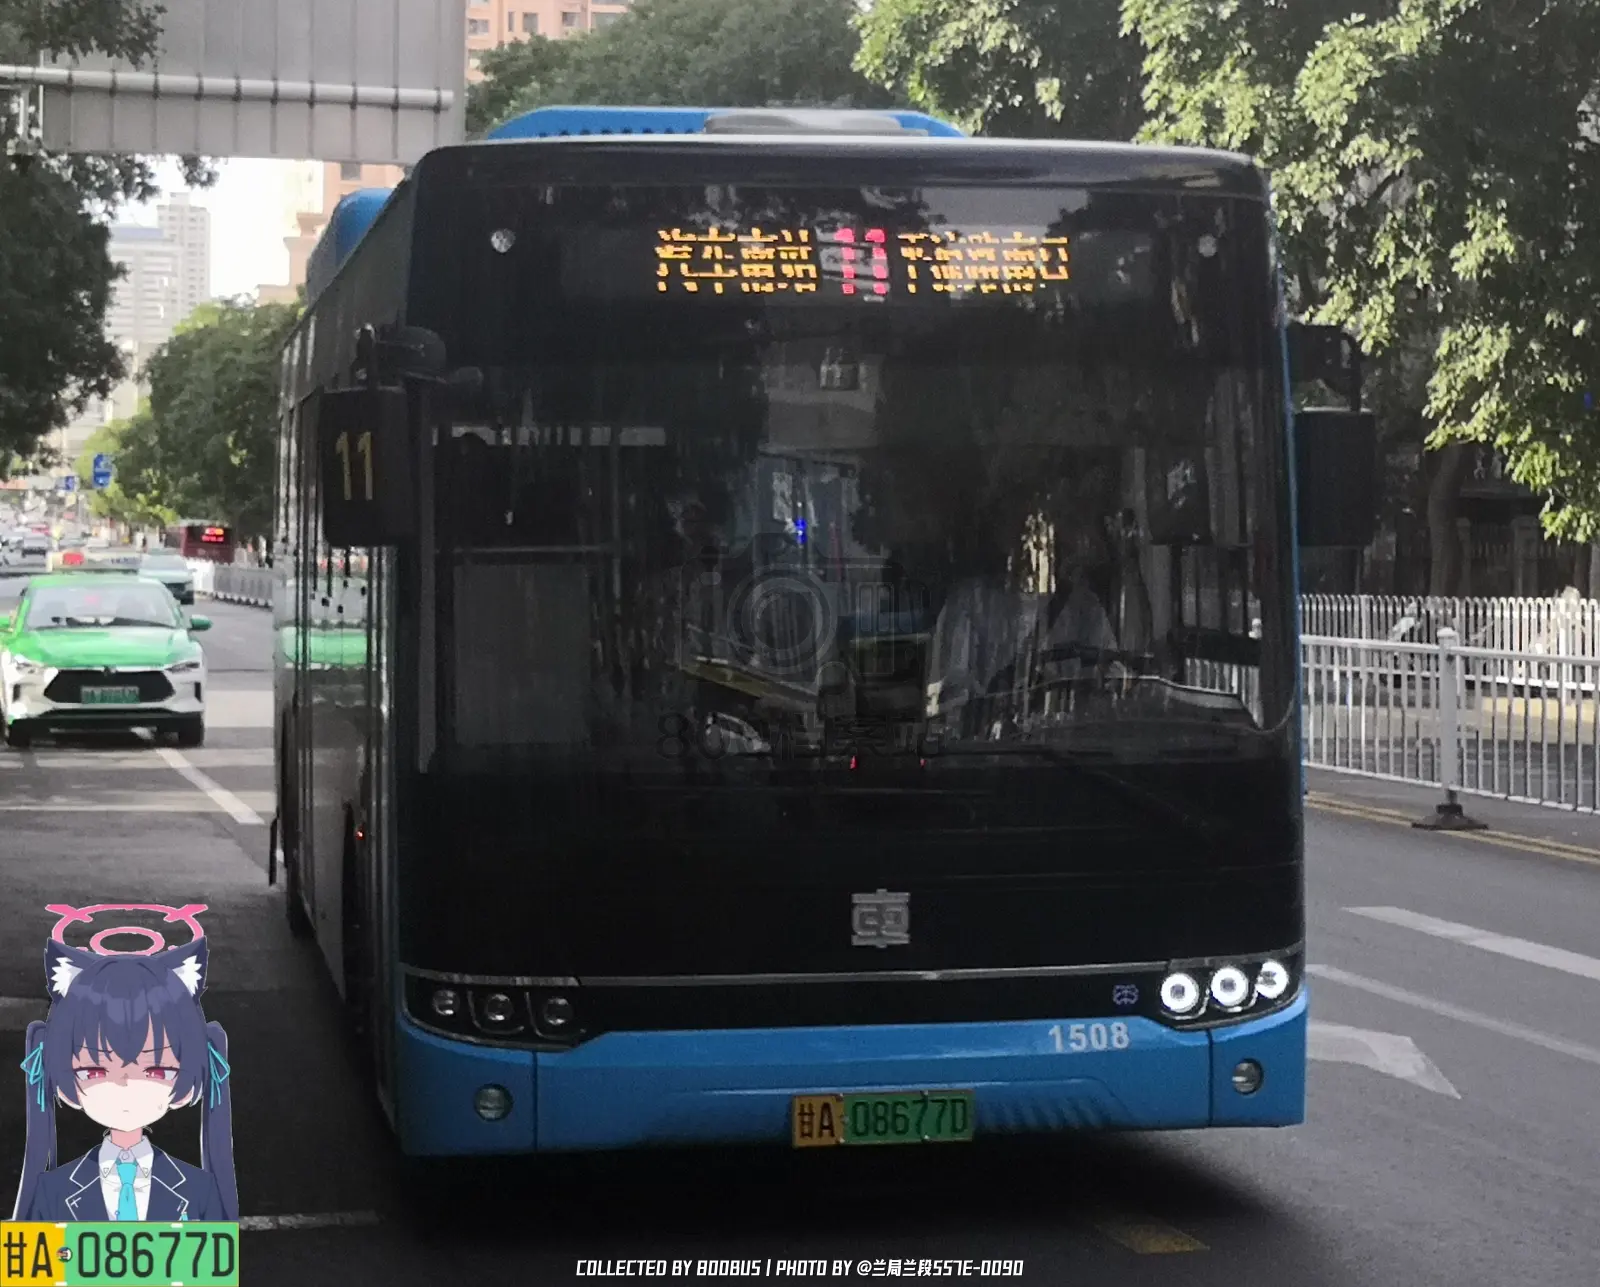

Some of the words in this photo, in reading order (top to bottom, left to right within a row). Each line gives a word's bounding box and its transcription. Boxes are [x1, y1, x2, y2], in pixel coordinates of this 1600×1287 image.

[834, 227, 888, 295] 11
[335, 431, 374, 500] 11
[1049, 1022, 1130, 1052] 1508
[852, 1098, 968, 1136] 08677D
